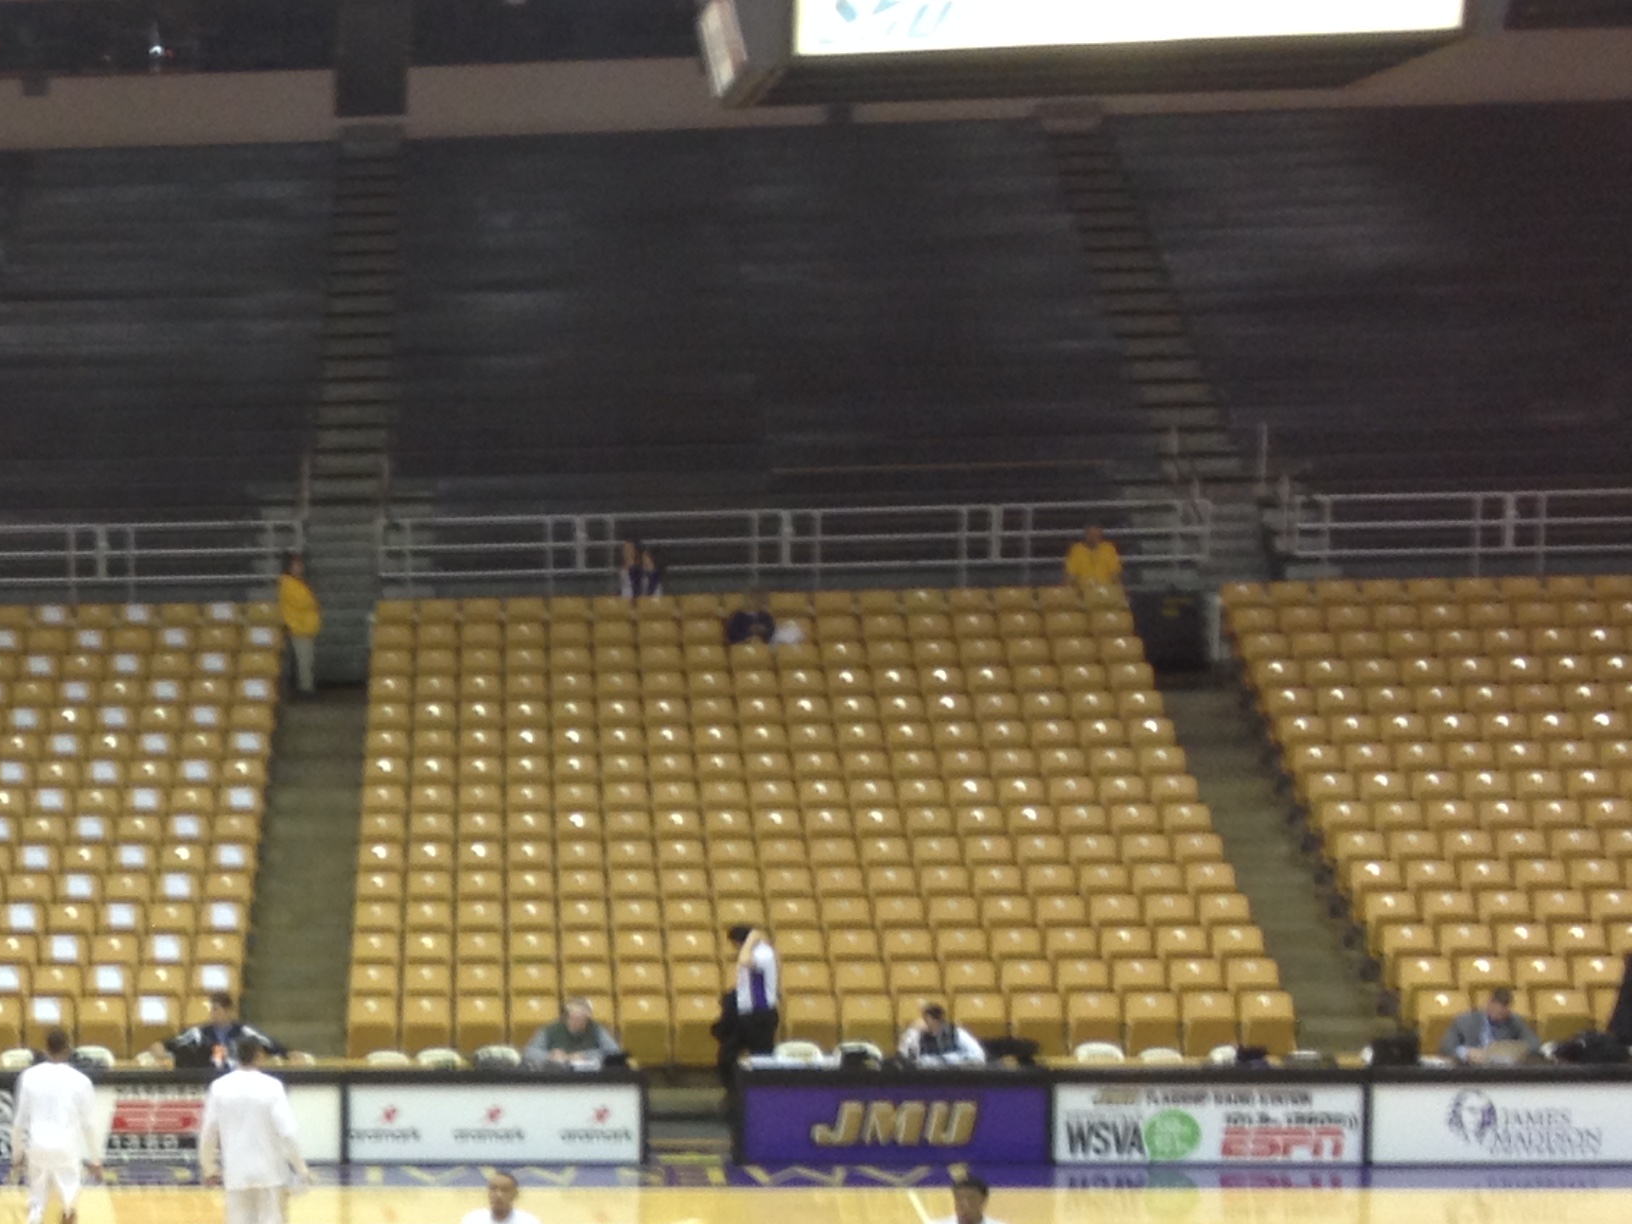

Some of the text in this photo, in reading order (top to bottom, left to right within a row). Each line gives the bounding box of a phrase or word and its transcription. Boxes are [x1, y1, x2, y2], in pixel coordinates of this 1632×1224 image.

[811, 1101, 977, 1146] JMU
[1499, 1107, 1571, 1126] JAMES
[1066, 1117, 1147, 1157] WSVA
[1222, 1126, 1344, 1158] ESPN
